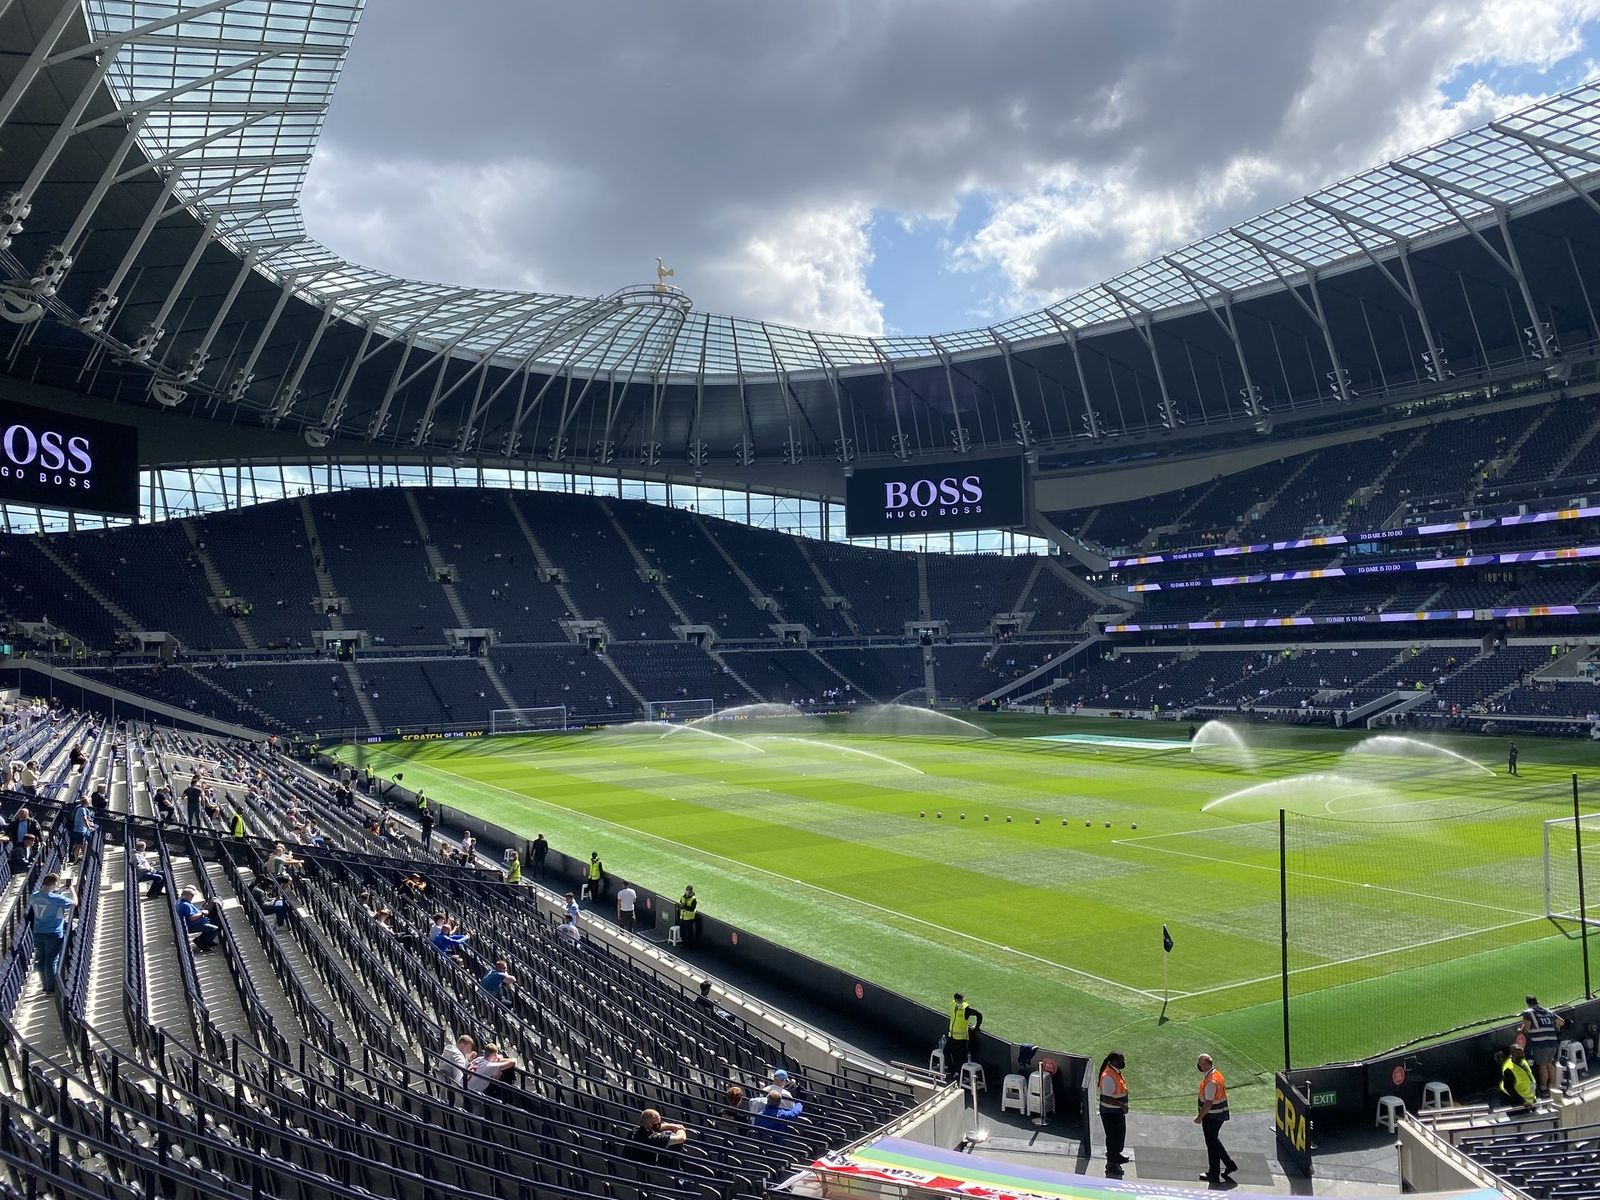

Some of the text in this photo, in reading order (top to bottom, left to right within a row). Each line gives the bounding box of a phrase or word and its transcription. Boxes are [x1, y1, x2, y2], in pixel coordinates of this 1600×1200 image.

[40, 472, 91, 489] BOSS
[884, 475, 983, 509] BOSS
[886, 505, 983, 519] HUGO BOSS
[34, 903, 47, 918] 17
[1540, 1017, 1552, 1025] 113
[1313, 1093, 1336, 1105] EXIT
